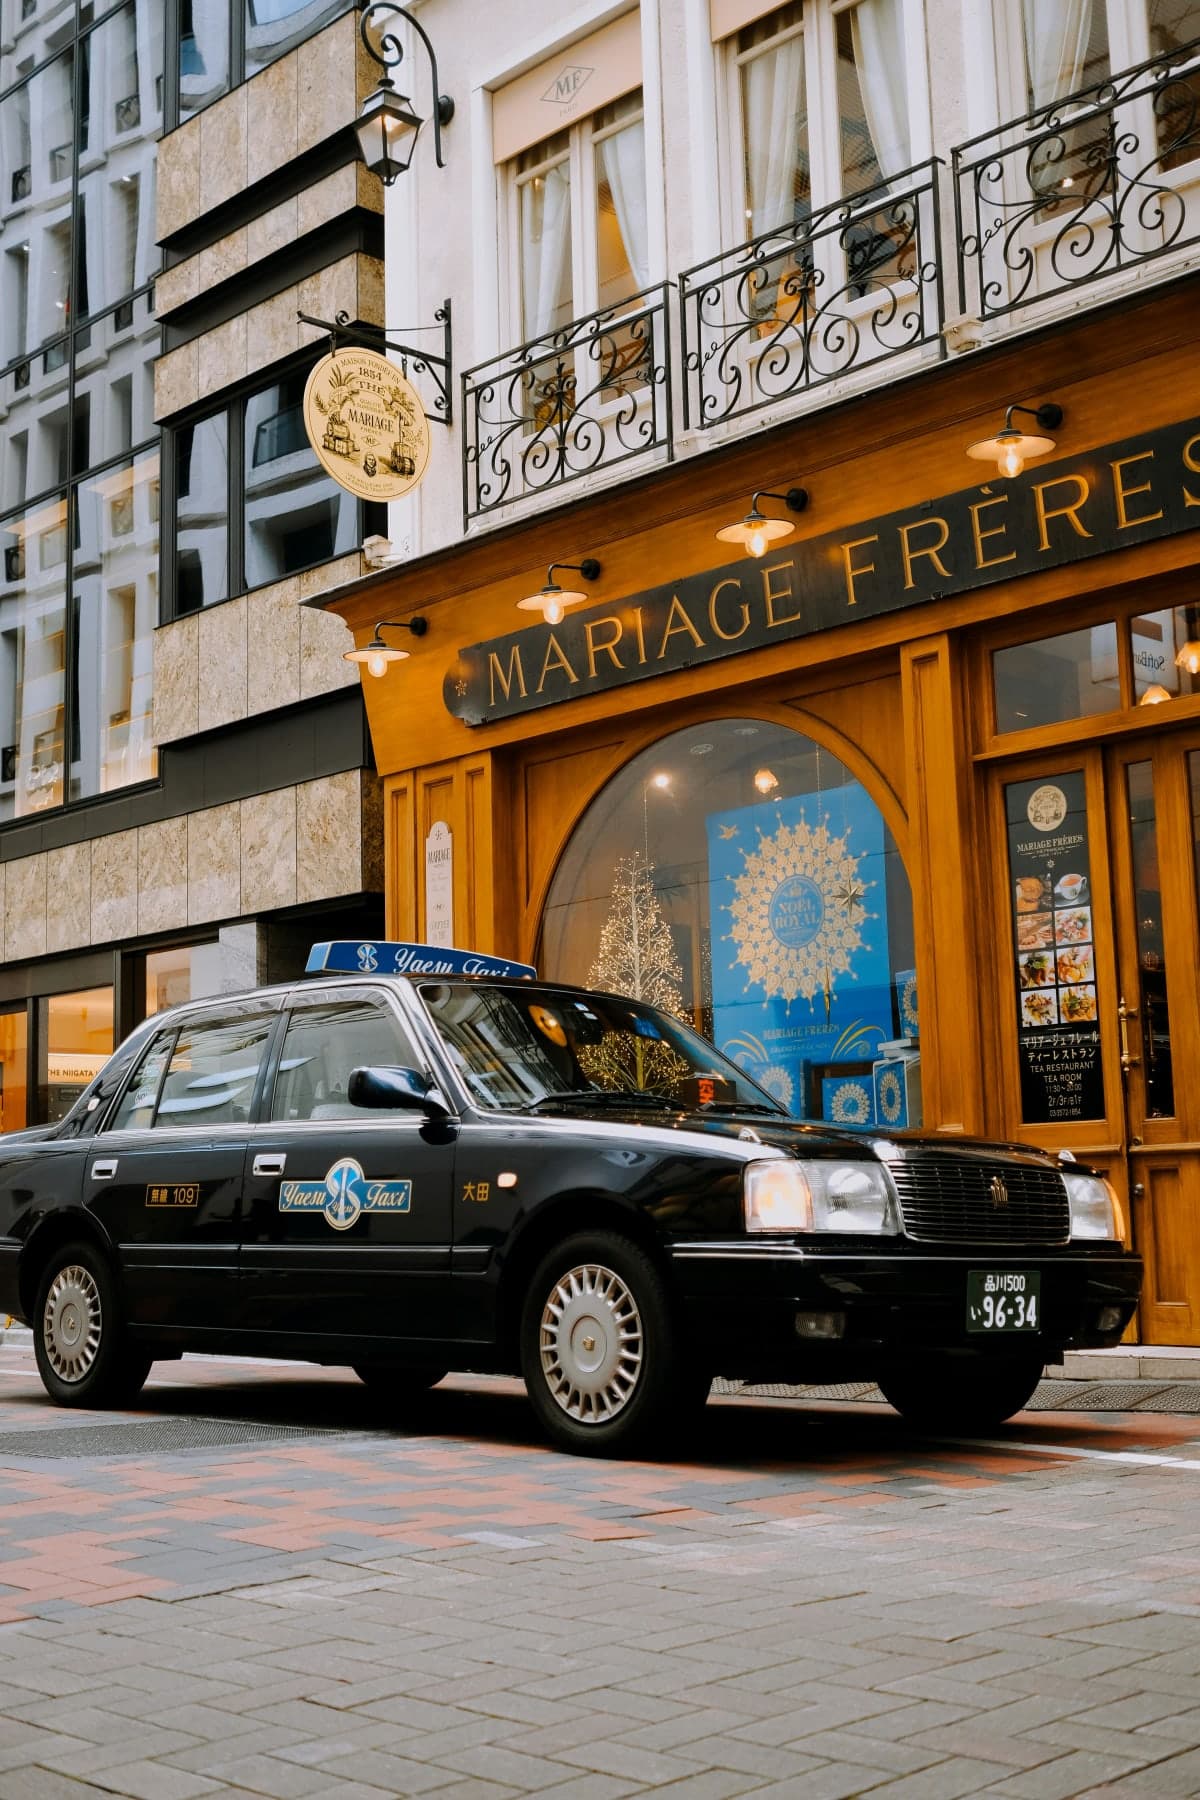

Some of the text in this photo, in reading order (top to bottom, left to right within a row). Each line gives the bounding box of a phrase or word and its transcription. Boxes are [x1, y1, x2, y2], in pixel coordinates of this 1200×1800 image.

[555, 69, 582, 100] MF
[358, 367, 383, 382] 1854
[349, 409, 394, 433] MARIAGE
[487, 560, 802, 708] MARIAGE
[1016, 839, 1052, 853] MARIAGE
[393, 947, 453, 974] Yaesu
[1030, 1061, 1095, 1073] TEA RESTAURANT
[1043, 1073, 1082, 1083] TEA ROOM
[173, 1187, 194, 1203] 109
[283, 1184, 408, 1210] Yaesu Taxi
[463, 1181, 490, 1202] 大田
